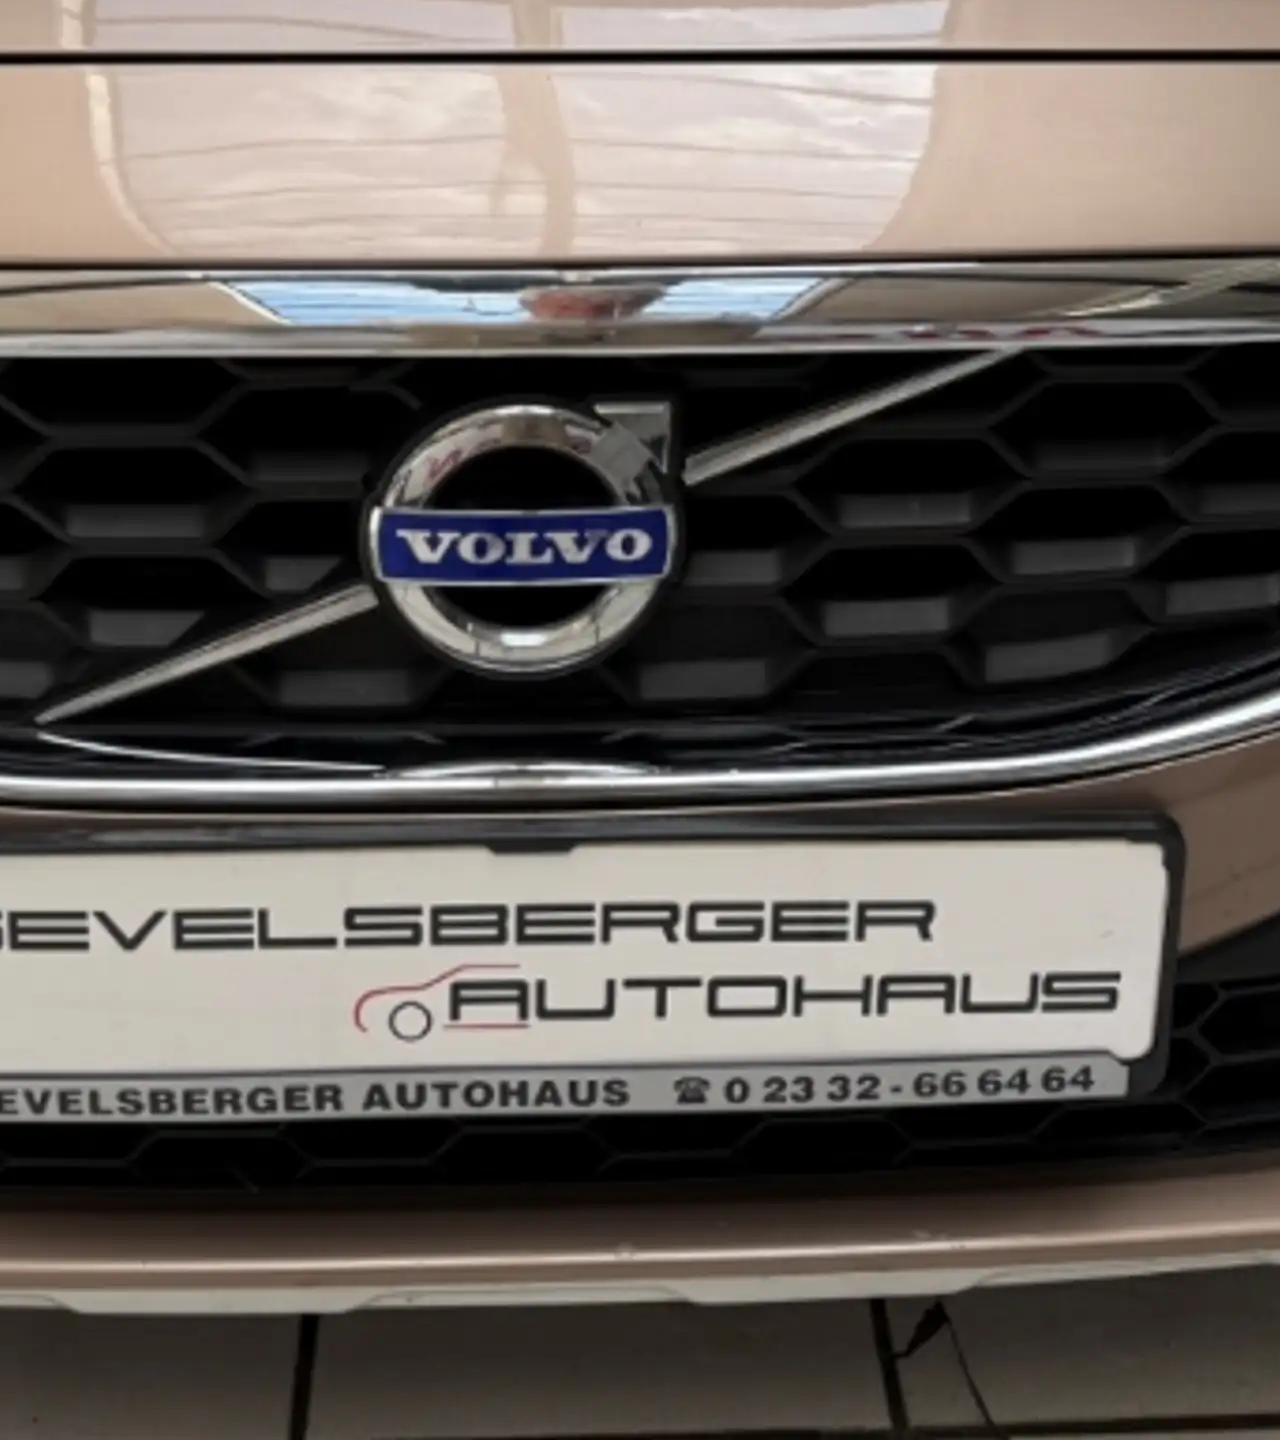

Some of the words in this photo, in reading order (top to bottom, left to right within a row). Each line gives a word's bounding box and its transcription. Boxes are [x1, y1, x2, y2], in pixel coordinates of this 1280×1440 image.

[396, 528, 652, 565] VOLVO
[448, 971, 1122, 1022] AUTOHAUS
[361, 1078, 630, 1111] AUTOHAUS
